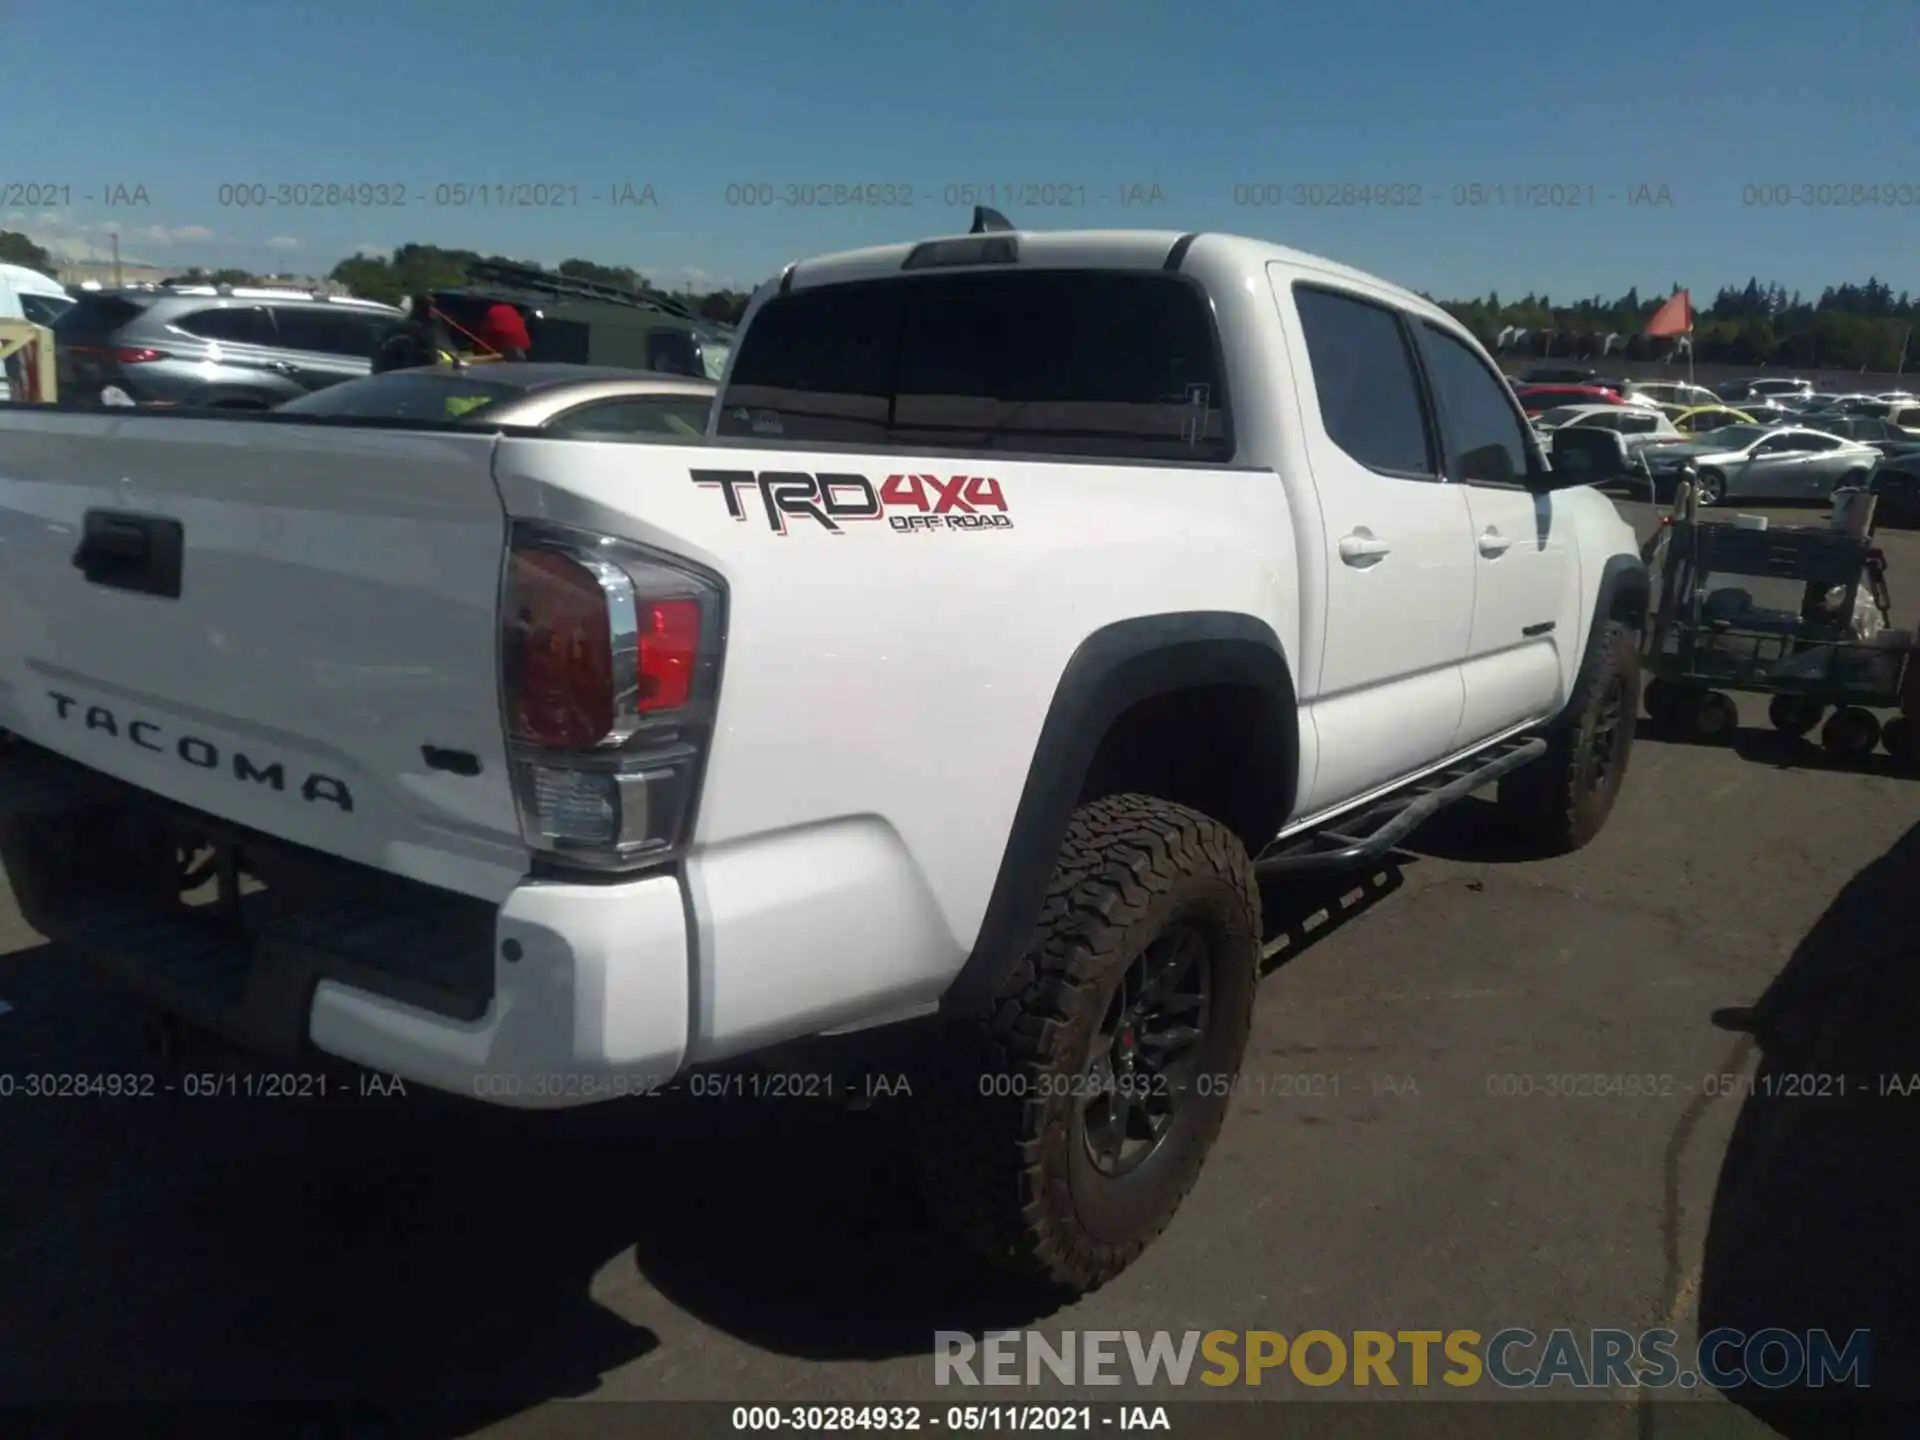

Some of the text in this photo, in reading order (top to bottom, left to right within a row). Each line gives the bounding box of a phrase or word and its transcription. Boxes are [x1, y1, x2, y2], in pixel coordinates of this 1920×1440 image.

[689, 468, 884, 536] TRD
[888, 514, 1014, 533] OFF ROAD
[47, 690, 354, 813] TACOMA
